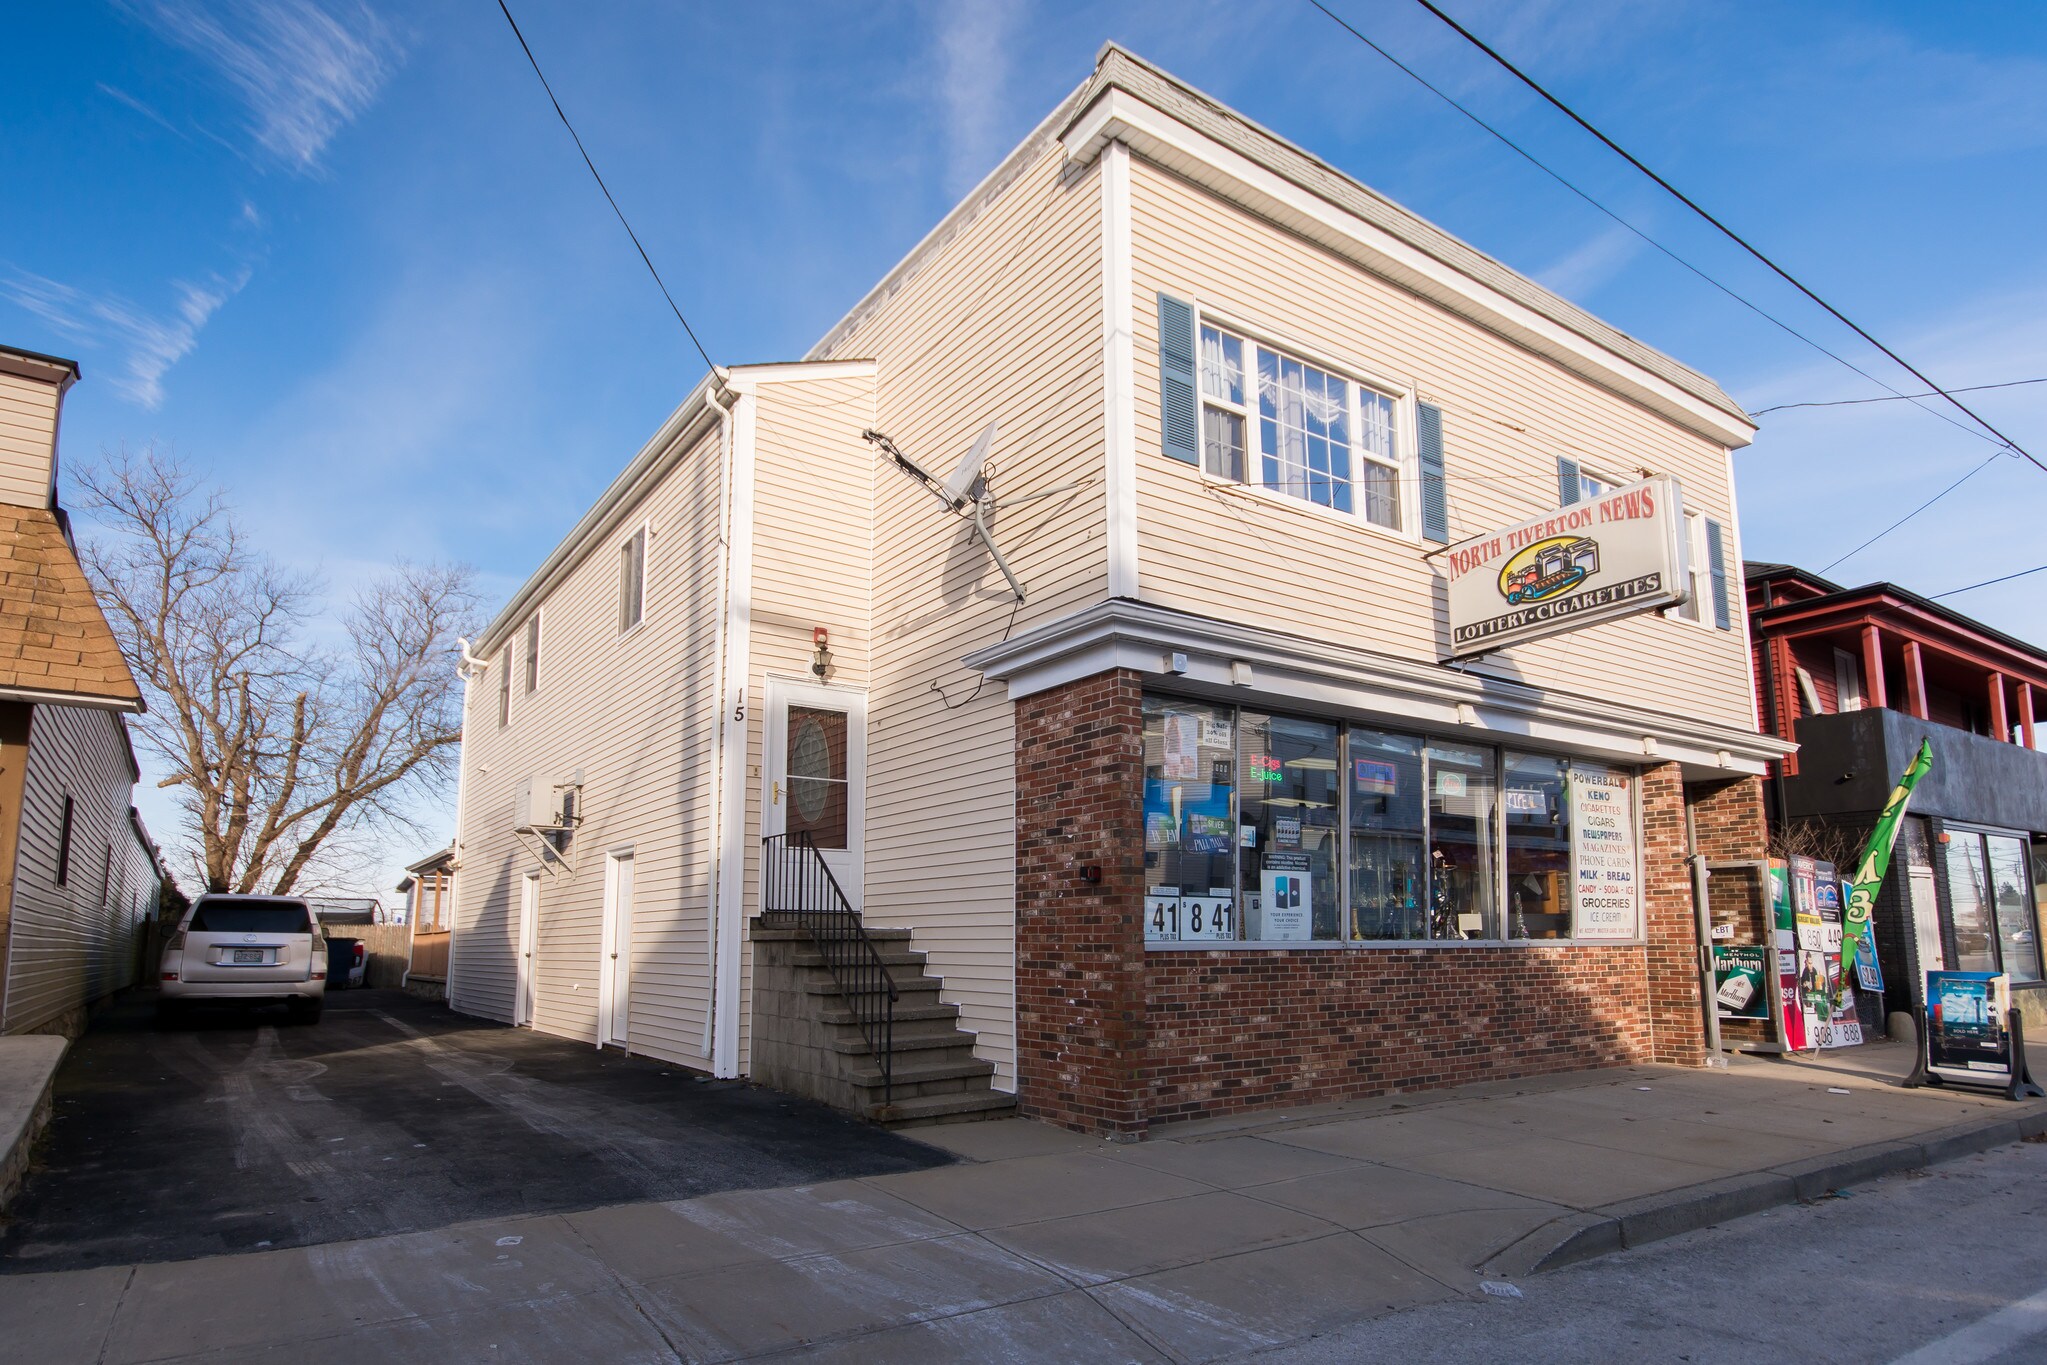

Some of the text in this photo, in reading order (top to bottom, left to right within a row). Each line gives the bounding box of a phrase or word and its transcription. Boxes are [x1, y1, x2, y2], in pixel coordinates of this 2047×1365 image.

[1449, 485, 1655, 582] NORTH TIVERTON NEWS
[1536, 575, 1660, 619] CIGARETTES
[1251, 754, 1280, 770] E-Cigs
[1250, 766, 1283, 781] E-Juice
[1358, 763, 1393, 781] OPEN
[1588, 790, 1610, 801] KENO
[1581, 802, 1621, 816] CIGARETTES
[1588, 816, 1615, 828] CIGARS
[1583, 842, 1627, 855] MAGAZINES
[1580, 855, 1631, 868] PHONE CARDS
[1580, 869, 1631, 881] MILK BREAD
[1578, 884, 1634, 895] CANDY SODA ICE
[1582, 898, 1630, 909] GROCERIES
[1590, 911, 1621, 922] ICE CREAM
[1716, 926, 1729, 934] EBT
[1720, 988, 1746, 1004] Marlboro
